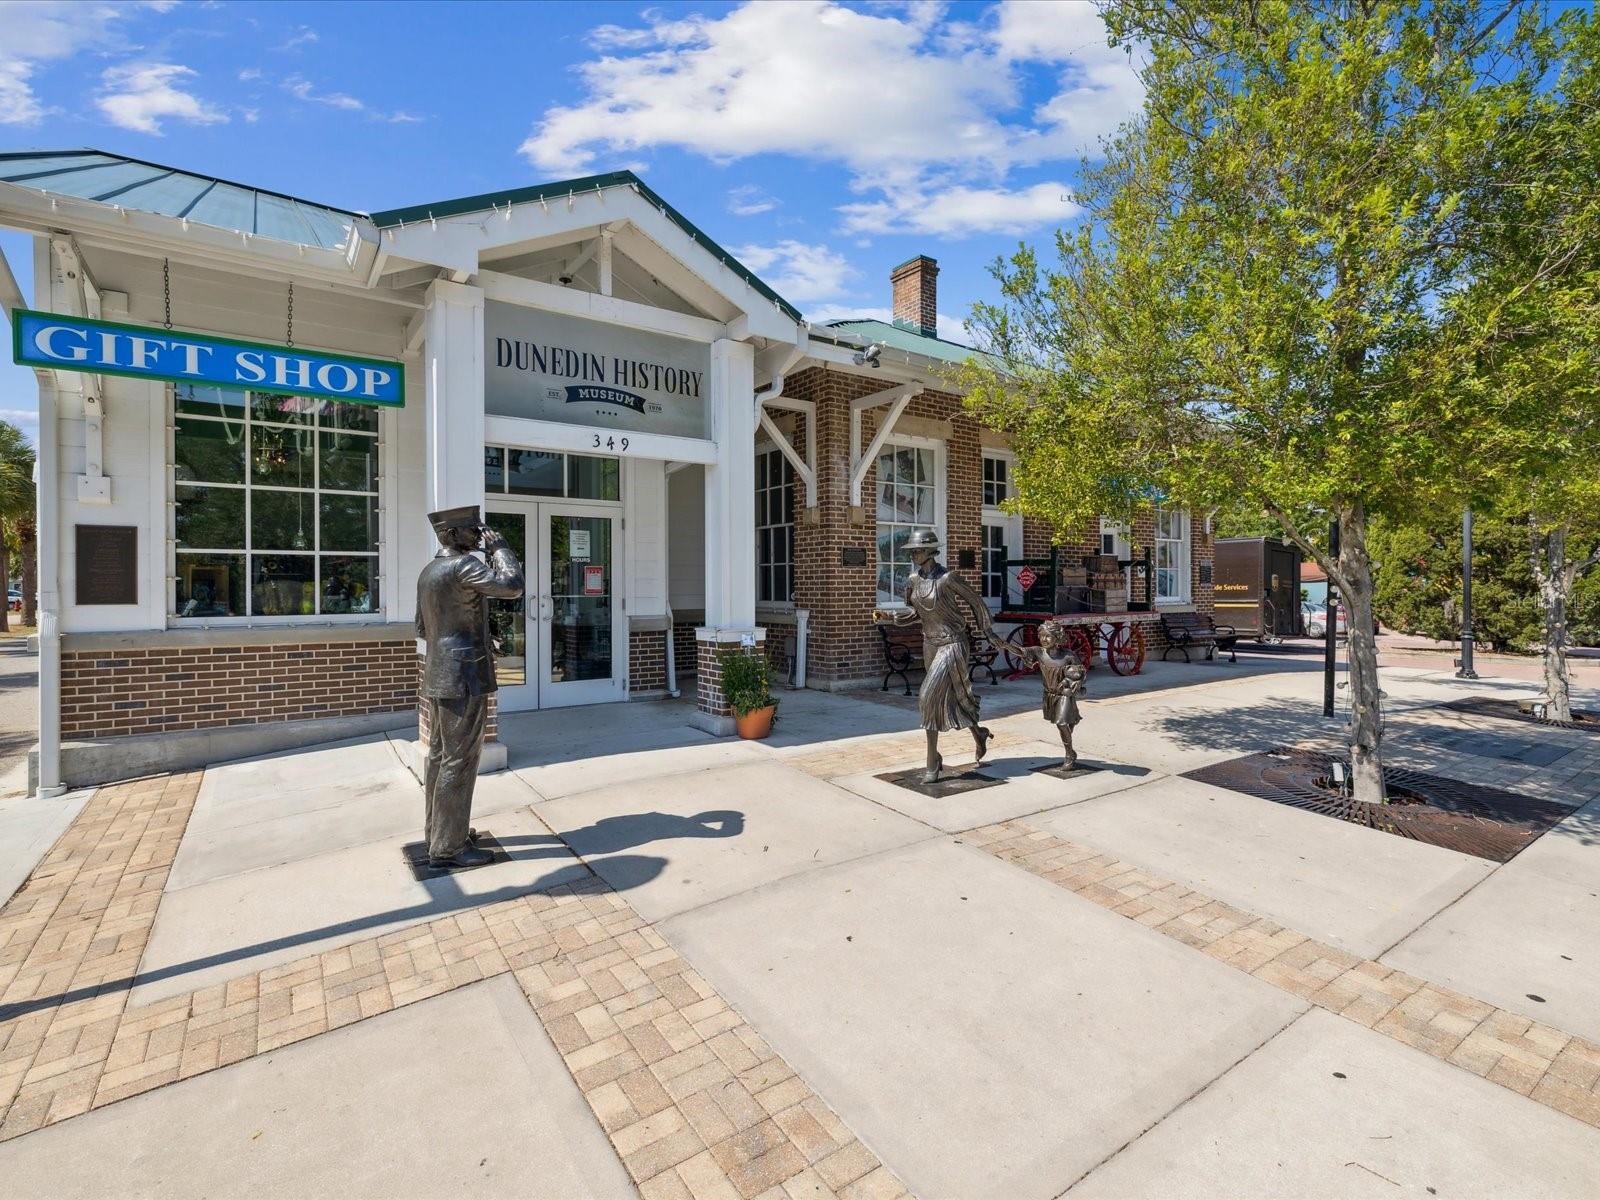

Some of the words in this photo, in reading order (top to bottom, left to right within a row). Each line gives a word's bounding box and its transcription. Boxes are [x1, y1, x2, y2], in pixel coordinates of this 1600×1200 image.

[34, 326, 213, 375] GIFT
[235, 352, 391, 397] SHOP
[495, 337, 606, 383] DUNEDIN
[614, 358, 703, 397] HISTORY
[578, 388, 635, 406] MUSEUM
[592, 434, 630, 452] 349
